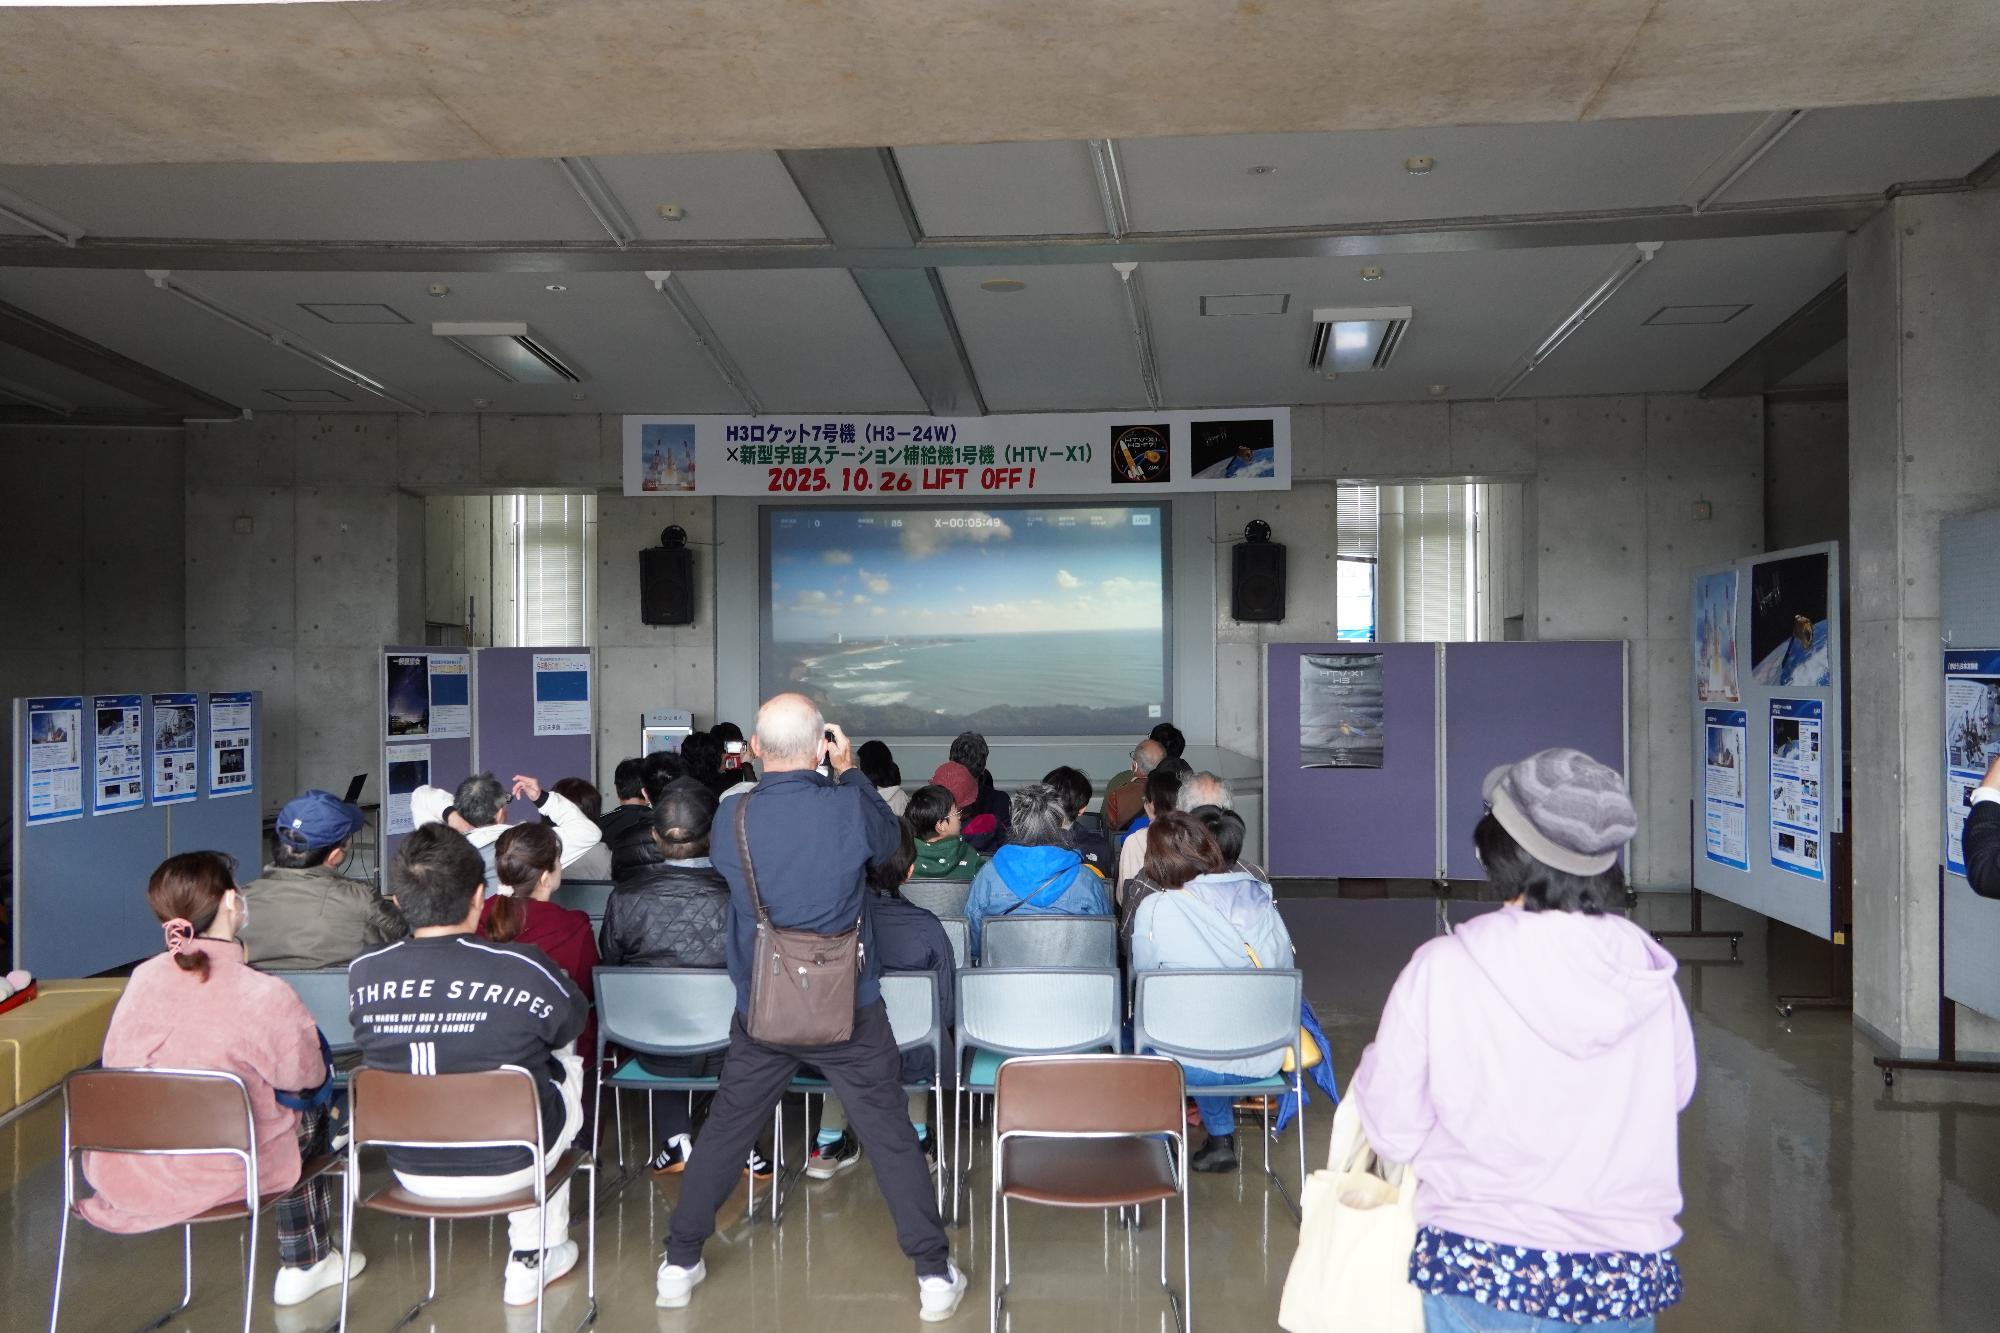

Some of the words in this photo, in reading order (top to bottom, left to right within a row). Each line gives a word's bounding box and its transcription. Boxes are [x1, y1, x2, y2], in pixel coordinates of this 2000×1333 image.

[879, 472, 913, 492] 26
[922, 468, 968, 490] LIFT
[357, 979, 435, 1005] THREE
[447, 981, 554, 1019] STRIPES
